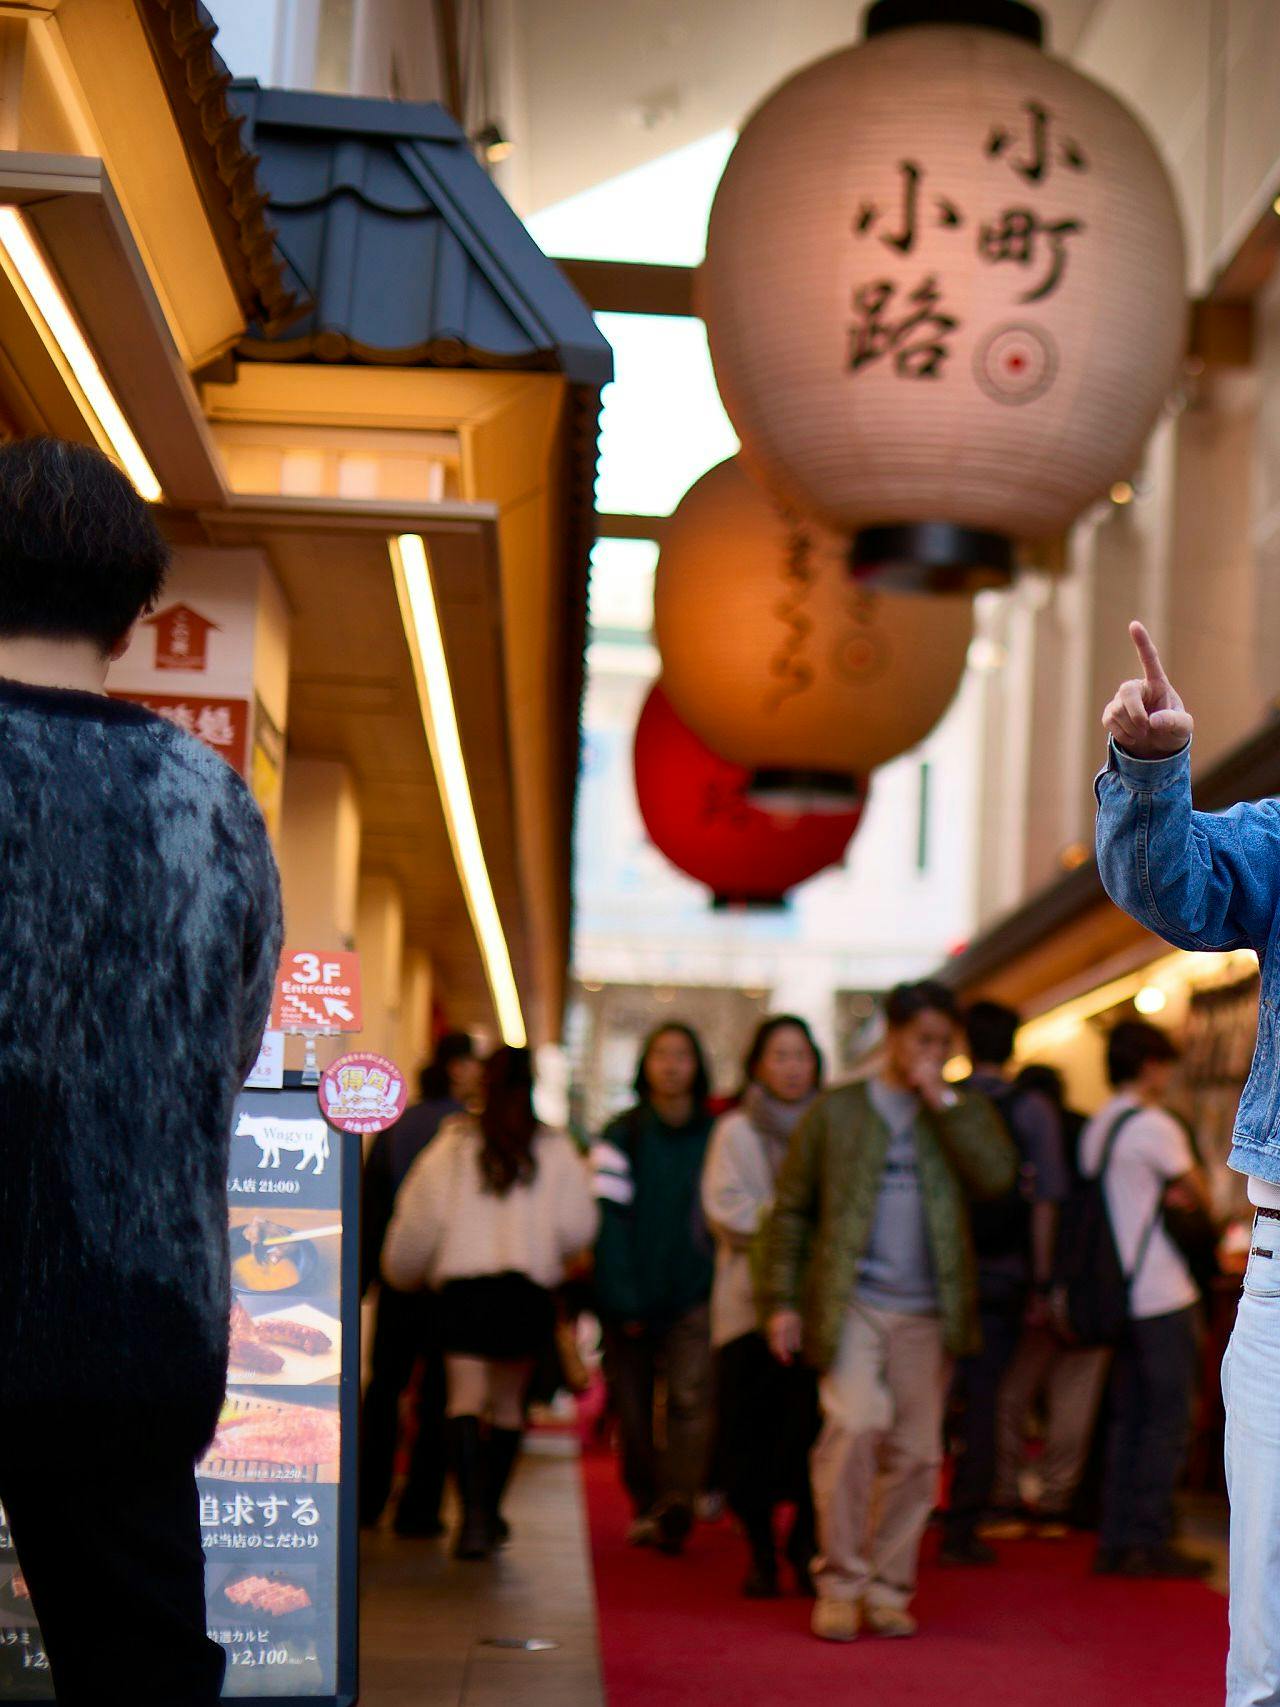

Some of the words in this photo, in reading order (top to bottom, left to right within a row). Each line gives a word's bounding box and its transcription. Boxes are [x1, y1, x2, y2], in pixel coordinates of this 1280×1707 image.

[977, 99, 1087, 304] 小町
[846, 158, 961, 381] 小路
[291, 952, 342, 985] 3F
[281, 980, 351, 997] Entrance
[264, 1127, 313, 1142] Wagyu
[227, 1179, 257, 1193] 入店
